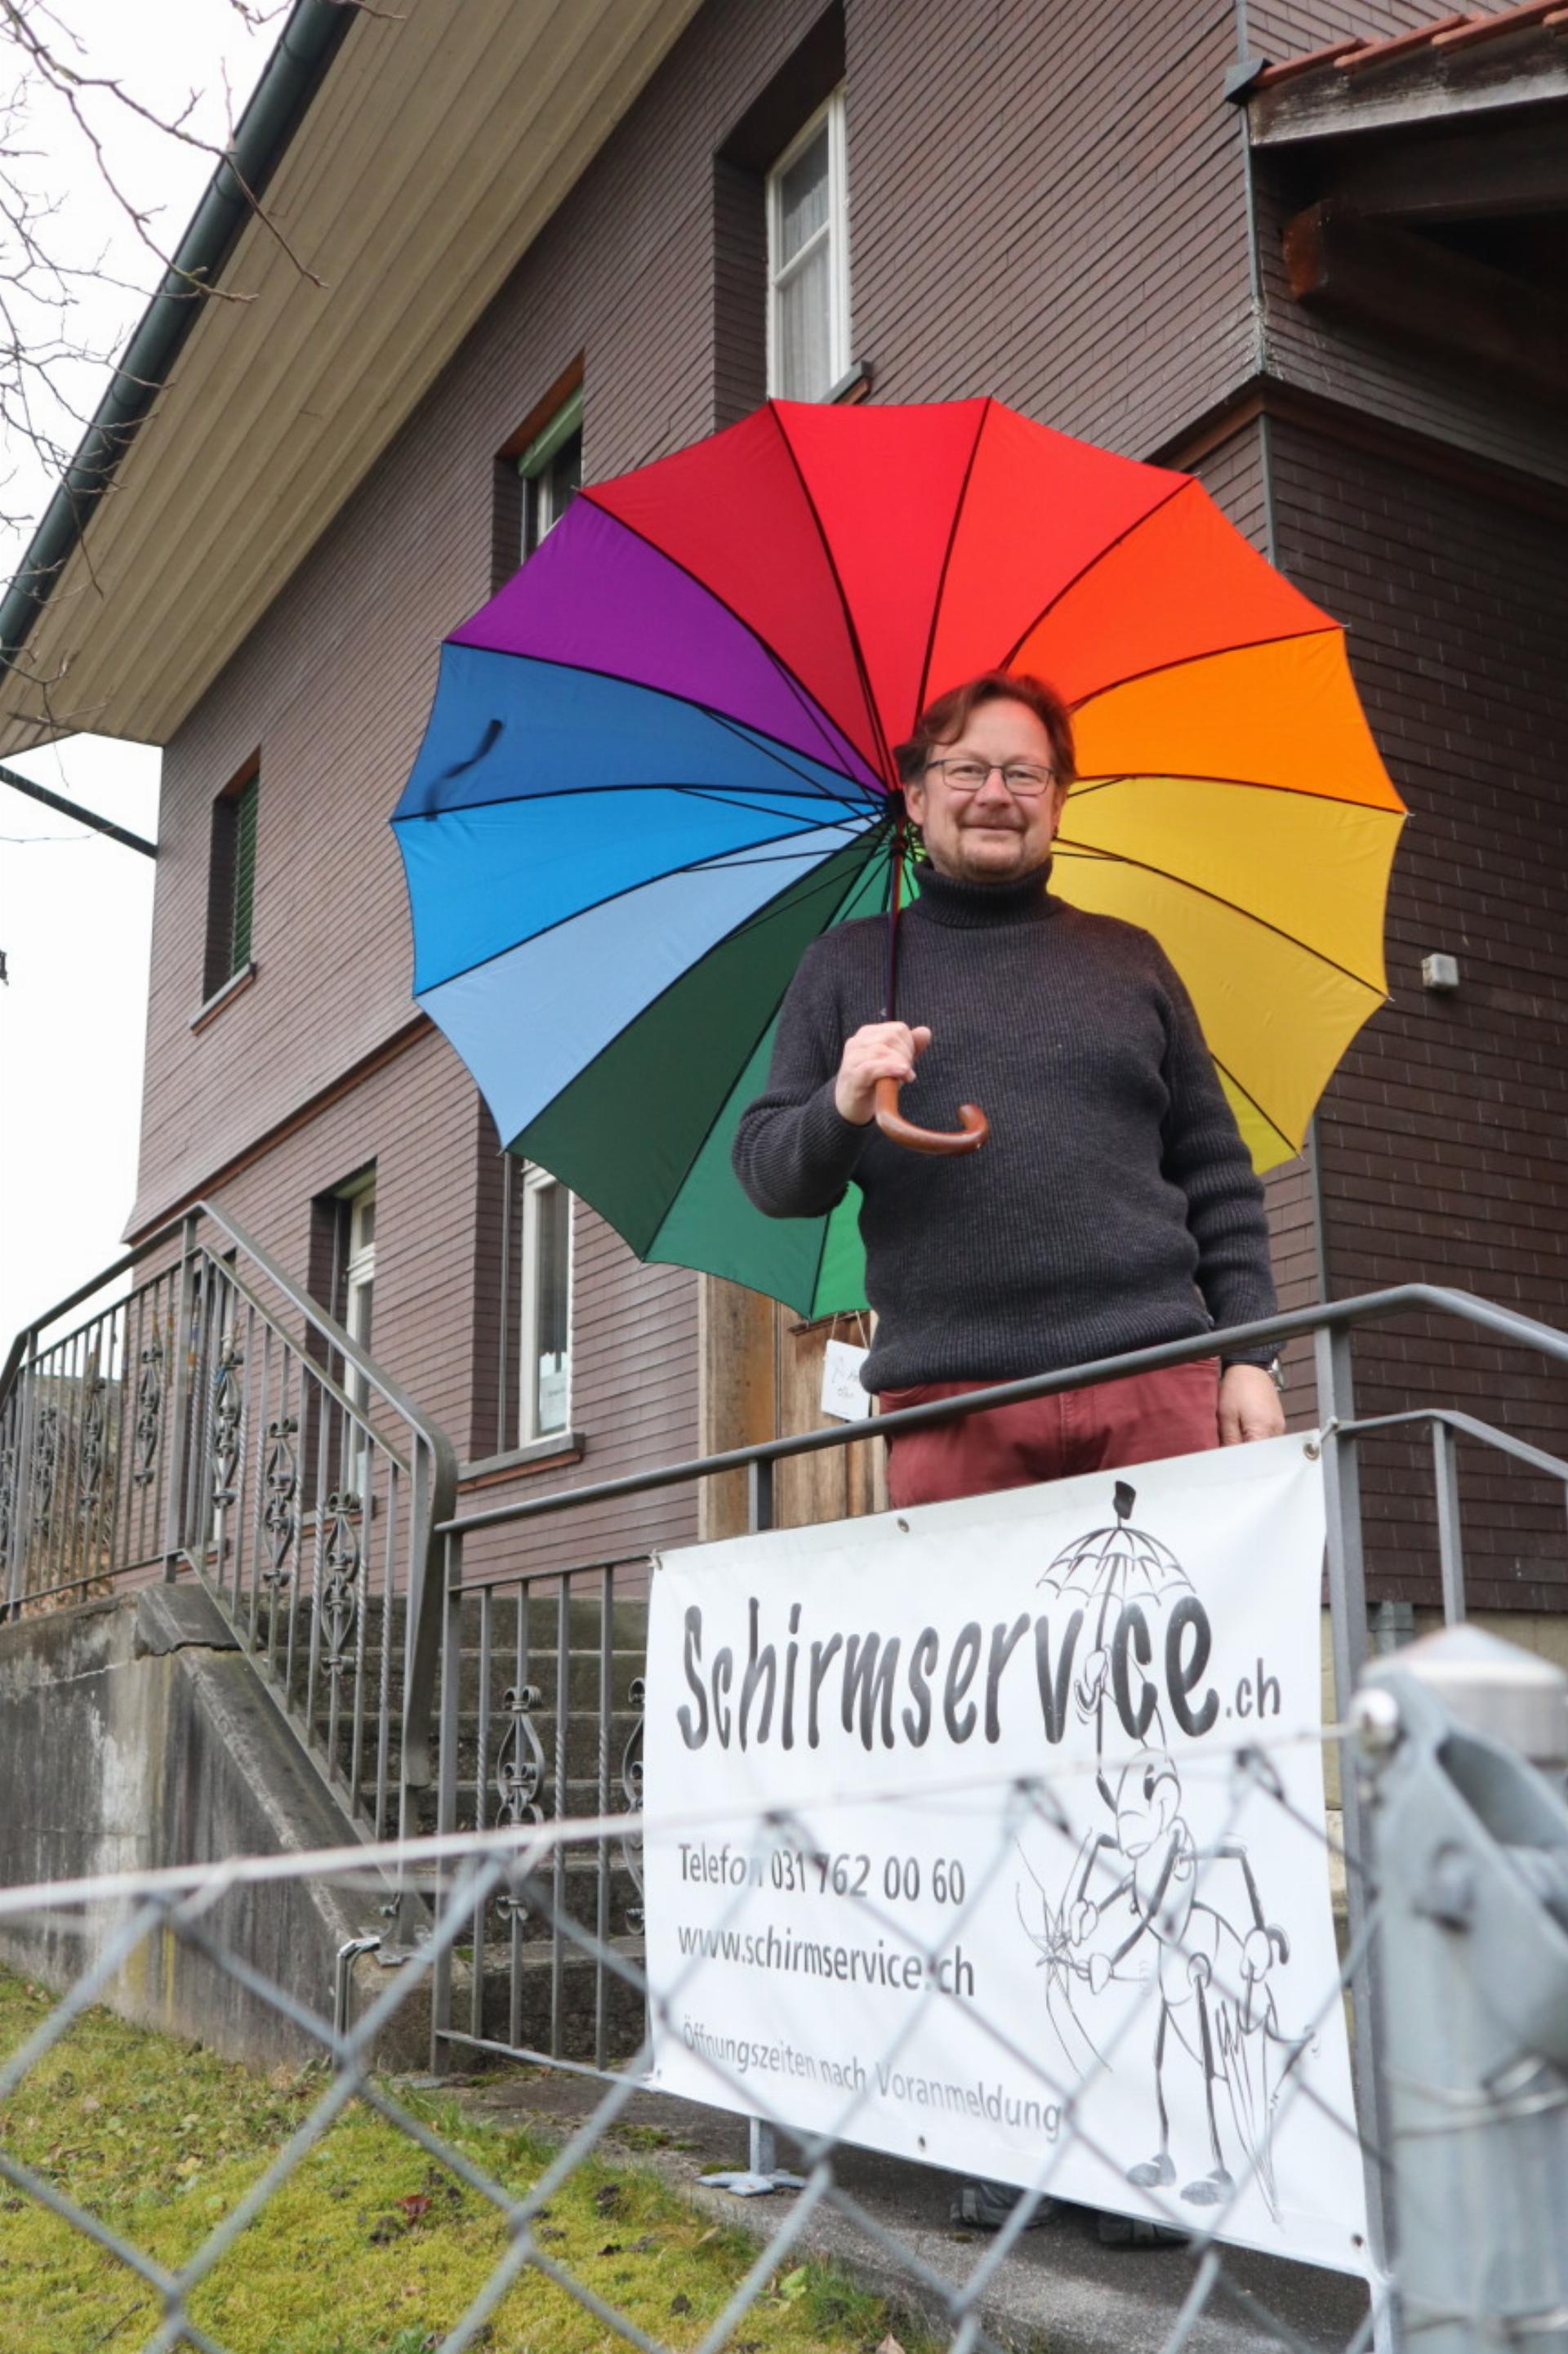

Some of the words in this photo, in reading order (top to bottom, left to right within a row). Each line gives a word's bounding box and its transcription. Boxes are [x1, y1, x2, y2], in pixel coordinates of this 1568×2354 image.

[771, 1849, 805, 1893] 031
[815, 1852, 871, 1897] 762
[884, 1855, 920, 1901] 00
[933, 1857, 965, 1906] 60
[678, 1924, 974, 1995] www.schirmservice.ch
[683, 2013, 817, 2080] Öffnungszeiten
[818, 2055, 866, 2093] nach
[875, 2062, 1062, 2143] Voranmeldung
